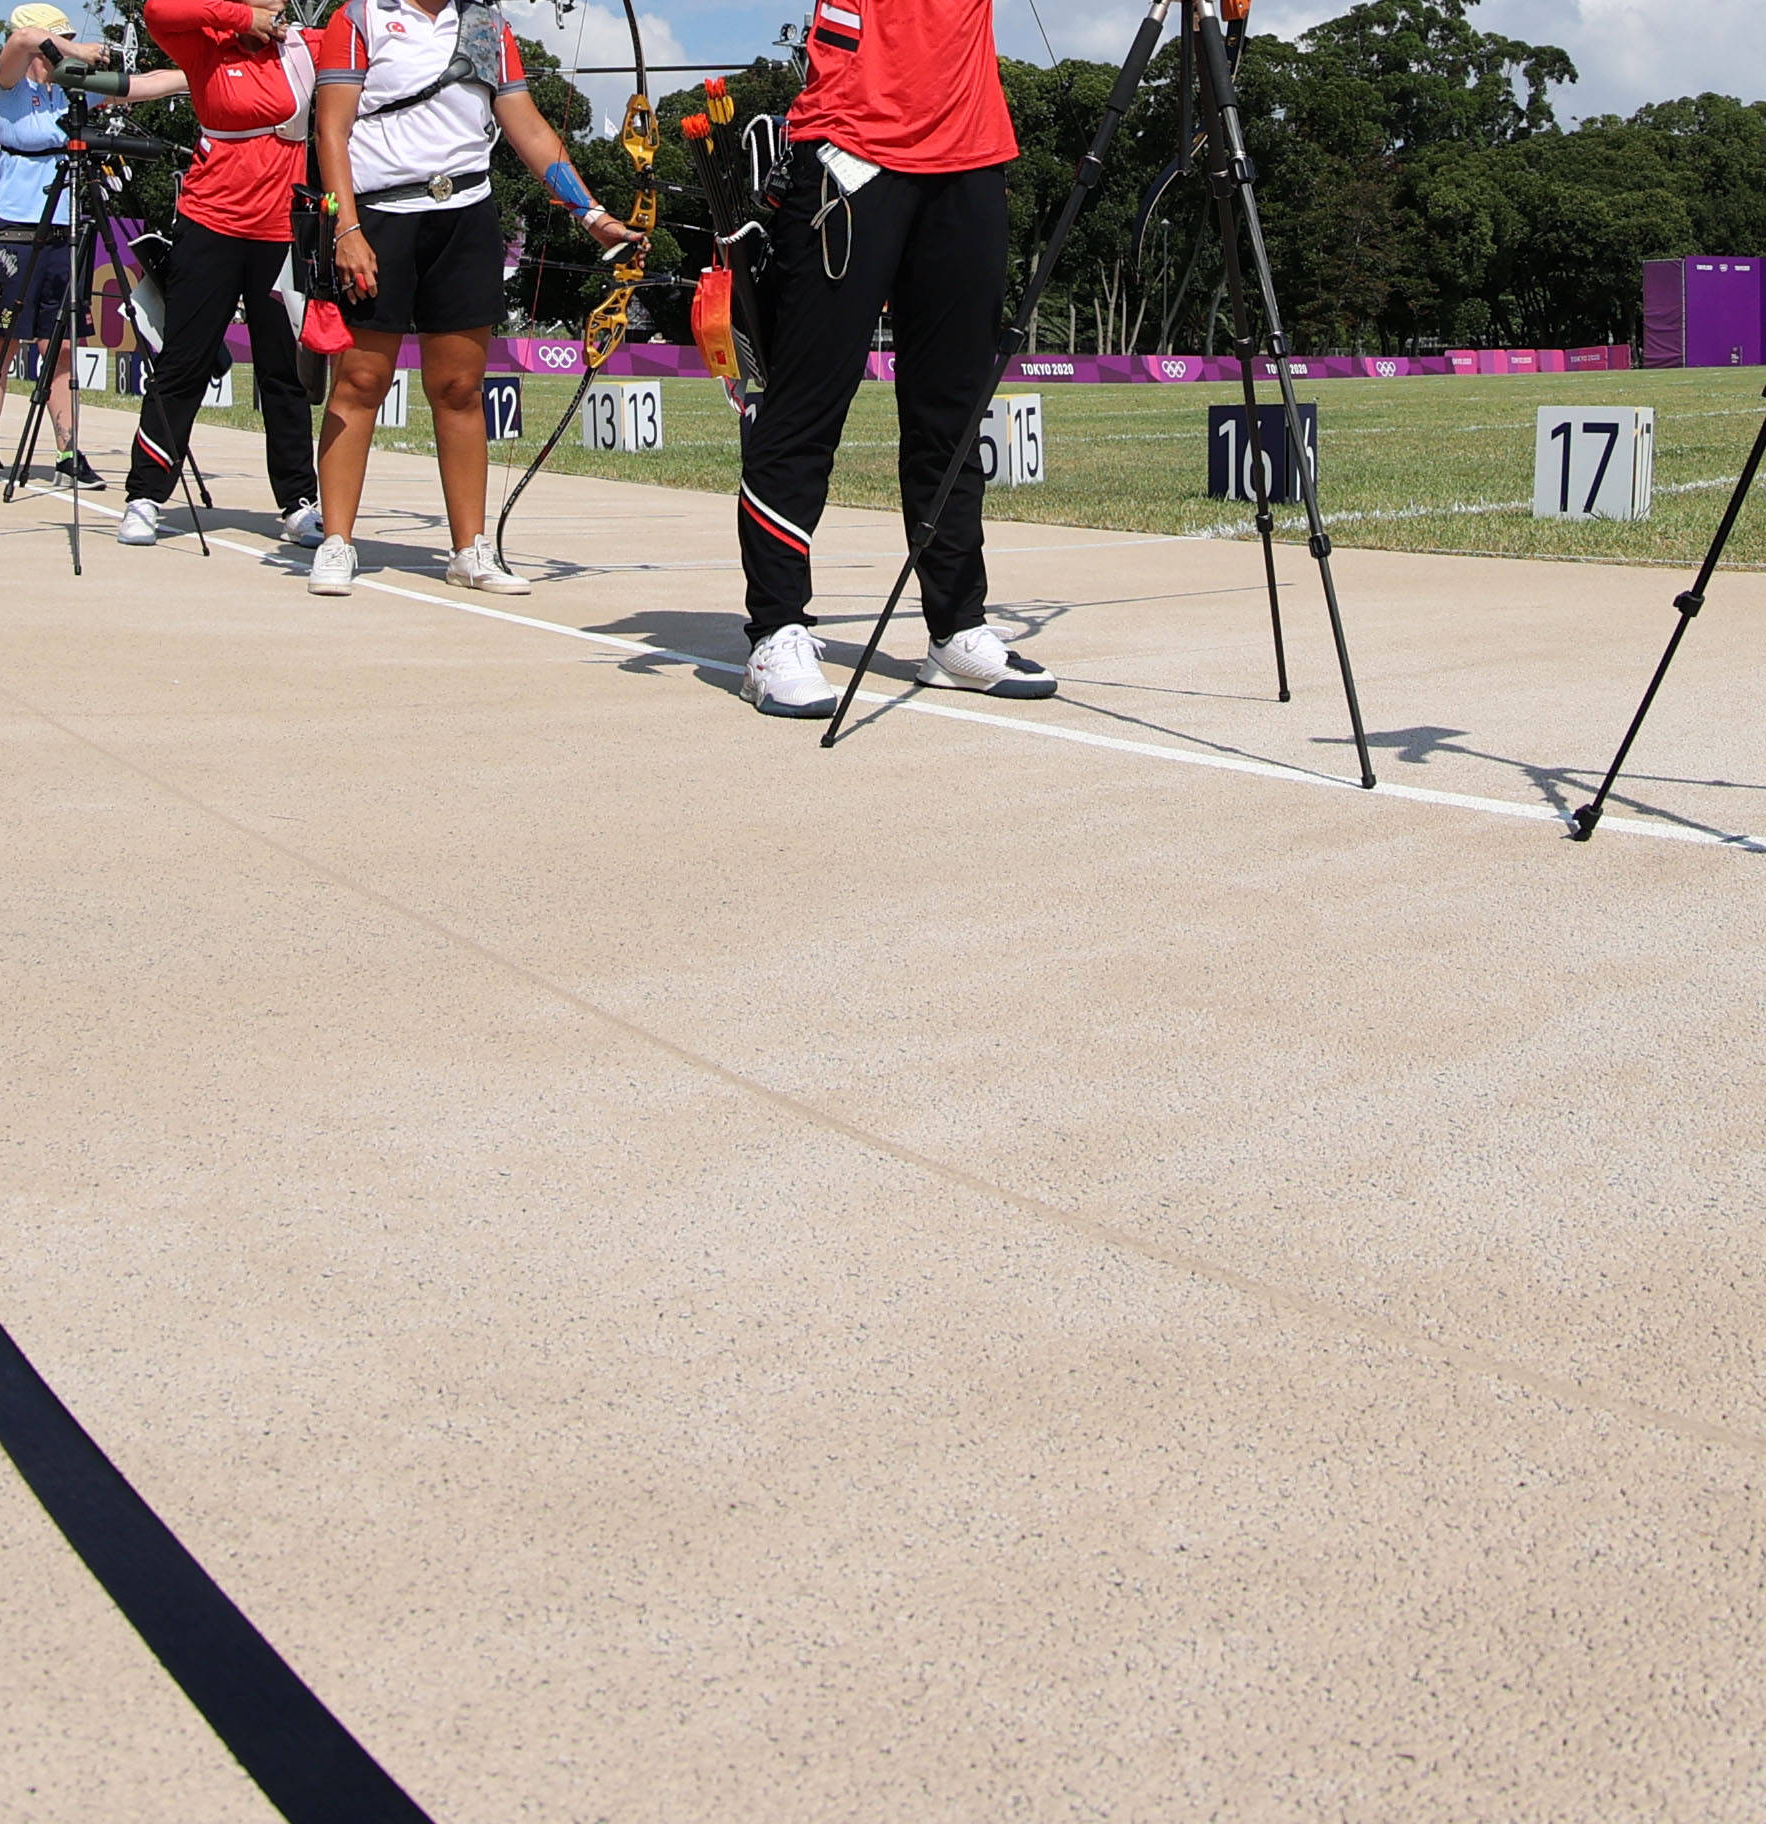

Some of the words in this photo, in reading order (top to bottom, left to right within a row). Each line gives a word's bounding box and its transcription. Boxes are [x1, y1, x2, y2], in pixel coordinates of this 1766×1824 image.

[86, 354, 99, 388] 7
[119, 357, 127, 394] 8
[1021, 363, 1051, 376] TOKYO
[1052, 363, 1074, 375] 2020
[488, 386, 519, 440] 12
[587, 393, 616, 451] 13
[628, 391, 657, 450] 13
[979, 410, 998, 482] 5
[1014, 406, 1039, 480] 15
[1218, 419, 1272, 502] 16
[1551, 422, 1619, 513] 17
